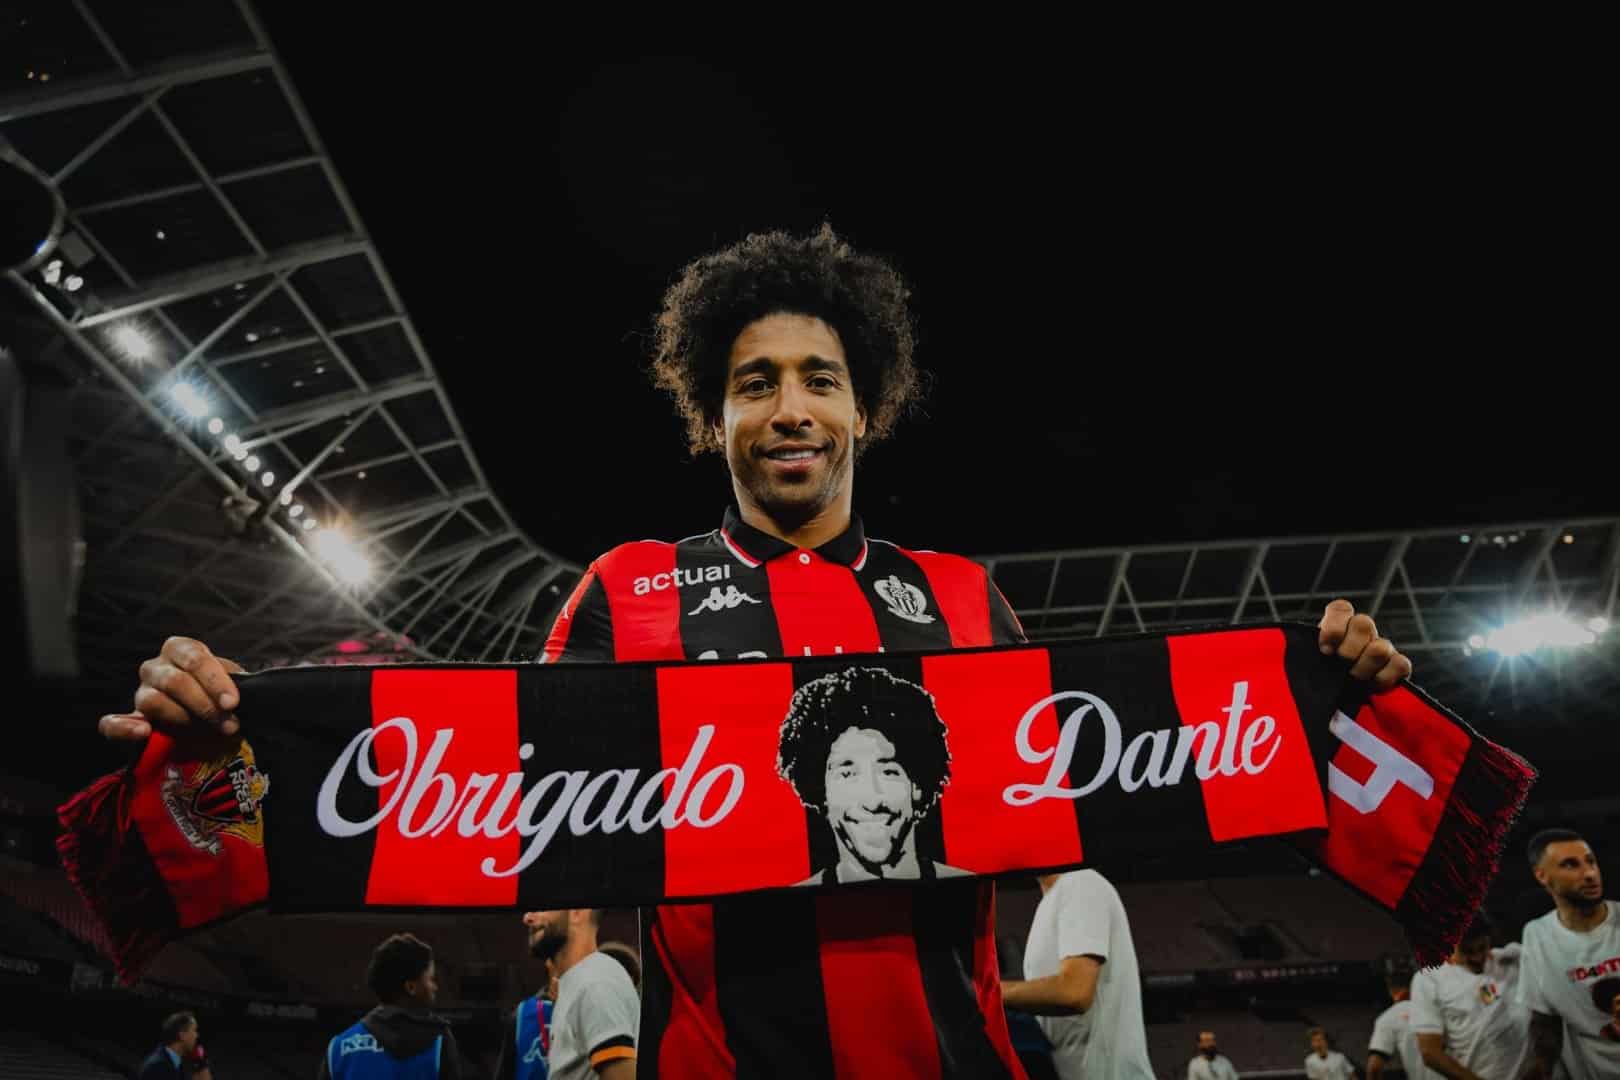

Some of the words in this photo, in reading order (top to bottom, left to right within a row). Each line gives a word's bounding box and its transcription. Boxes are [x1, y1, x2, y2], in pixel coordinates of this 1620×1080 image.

[633, 564, 731, 596] actual
[316, 716, 745, 878] Obrigado
[1002, 680, 1282, 807] Dante
